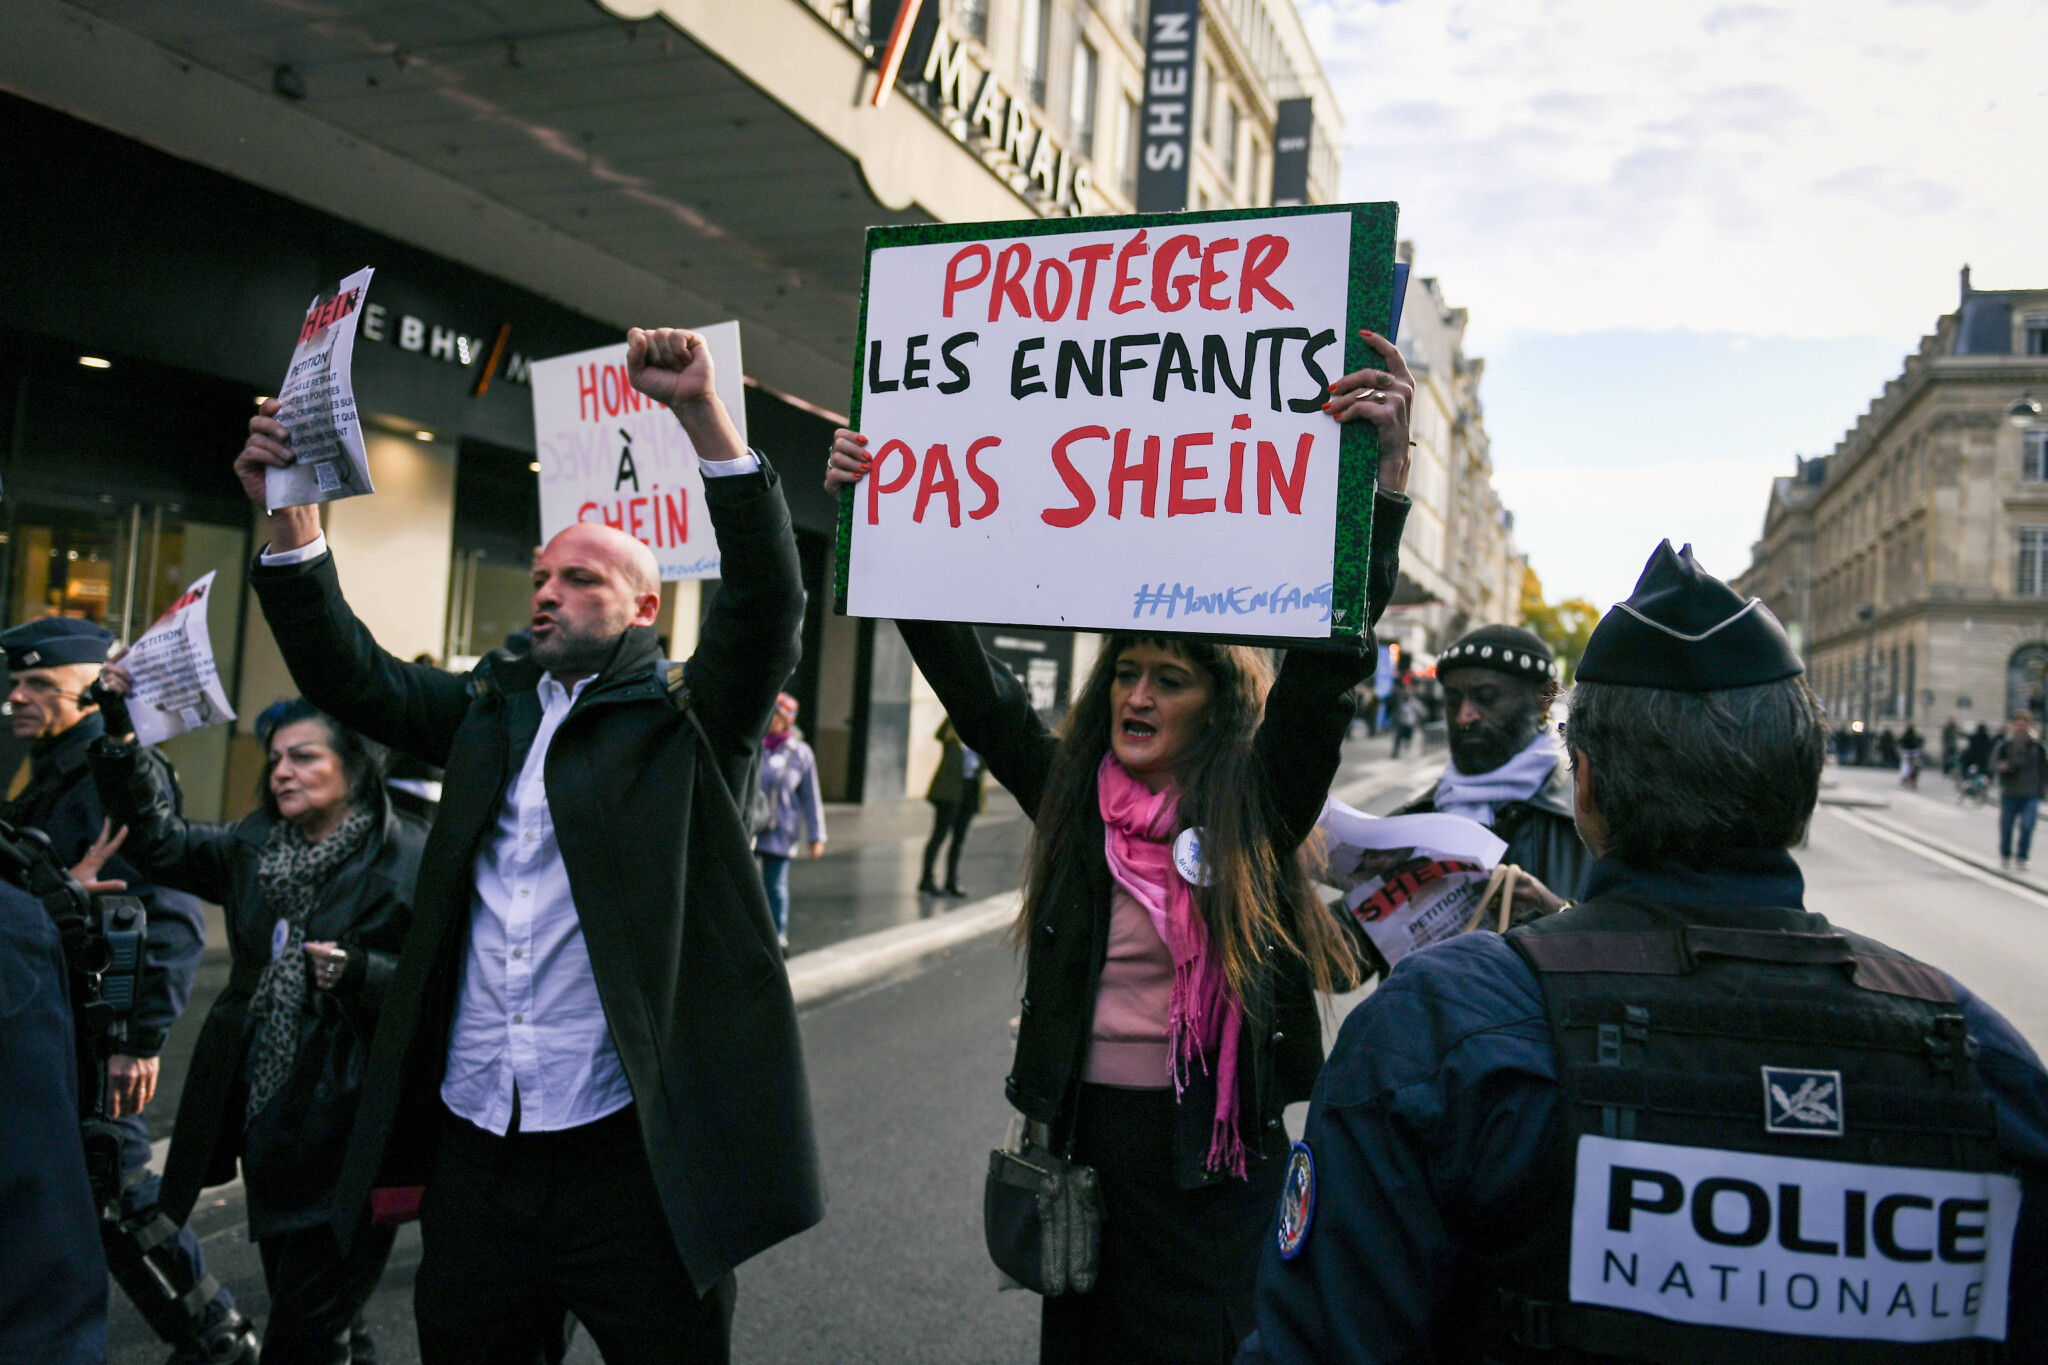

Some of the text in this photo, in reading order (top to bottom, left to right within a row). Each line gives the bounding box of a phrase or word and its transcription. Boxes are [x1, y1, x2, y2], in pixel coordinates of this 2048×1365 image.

[924, 21, 1092, 217] MARAIS
[1145, 12, 1190, 171] SHEIN
[942, 229, 1294, 322] PROTÉGER
[302, 287, 360, 338] HEIN
[363, 303, 482, 366] E BHV
[290, 352, 328, 378] PETITION
[578, 363, 667, 423] HON
[868, 327, 1337, 413] LES ENFANTS
[615, 428, 639, 492] À
[868, 435, 1002, 528] PAS
[1358, 861, 1483, 922] SHEIN
[1408, 885, 1467, 935] PETITION
[1606, 1164, 1990, 1264] POLICE
[1603, 1249, 1982, 1319] NATIONALE
